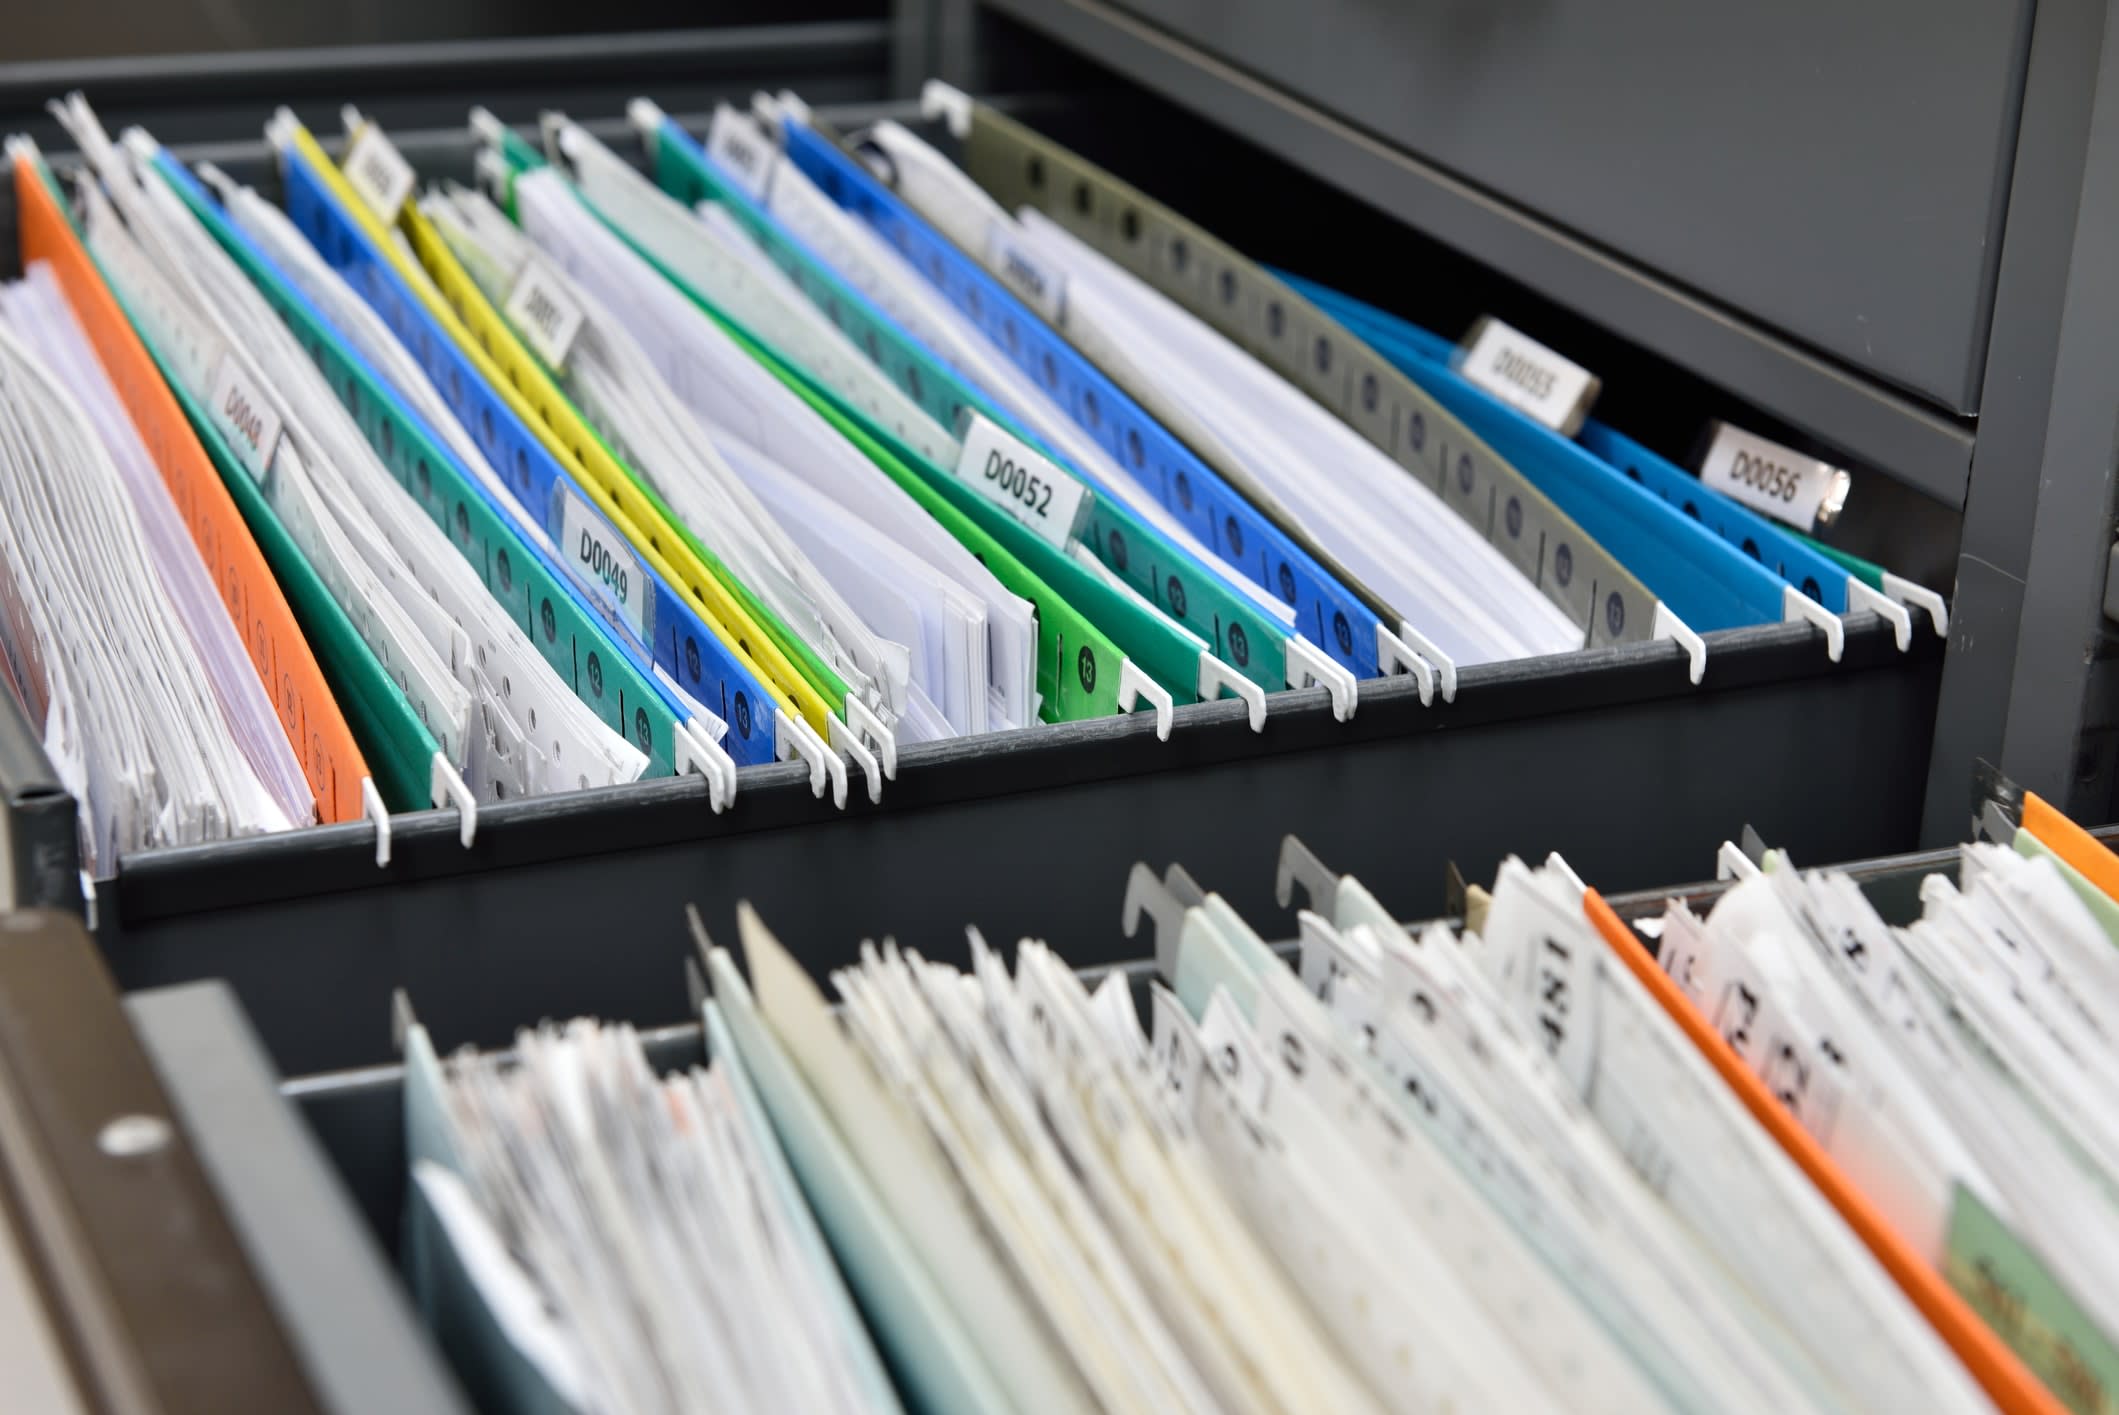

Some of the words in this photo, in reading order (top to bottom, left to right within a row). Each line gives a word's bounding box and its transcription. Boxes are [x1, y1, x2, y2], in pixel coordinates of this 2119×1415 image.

[984, 449, 1053, 518] D0052
[1730, 450, 1801, 503] D0056
[580, 527, 628, 605] D0049
